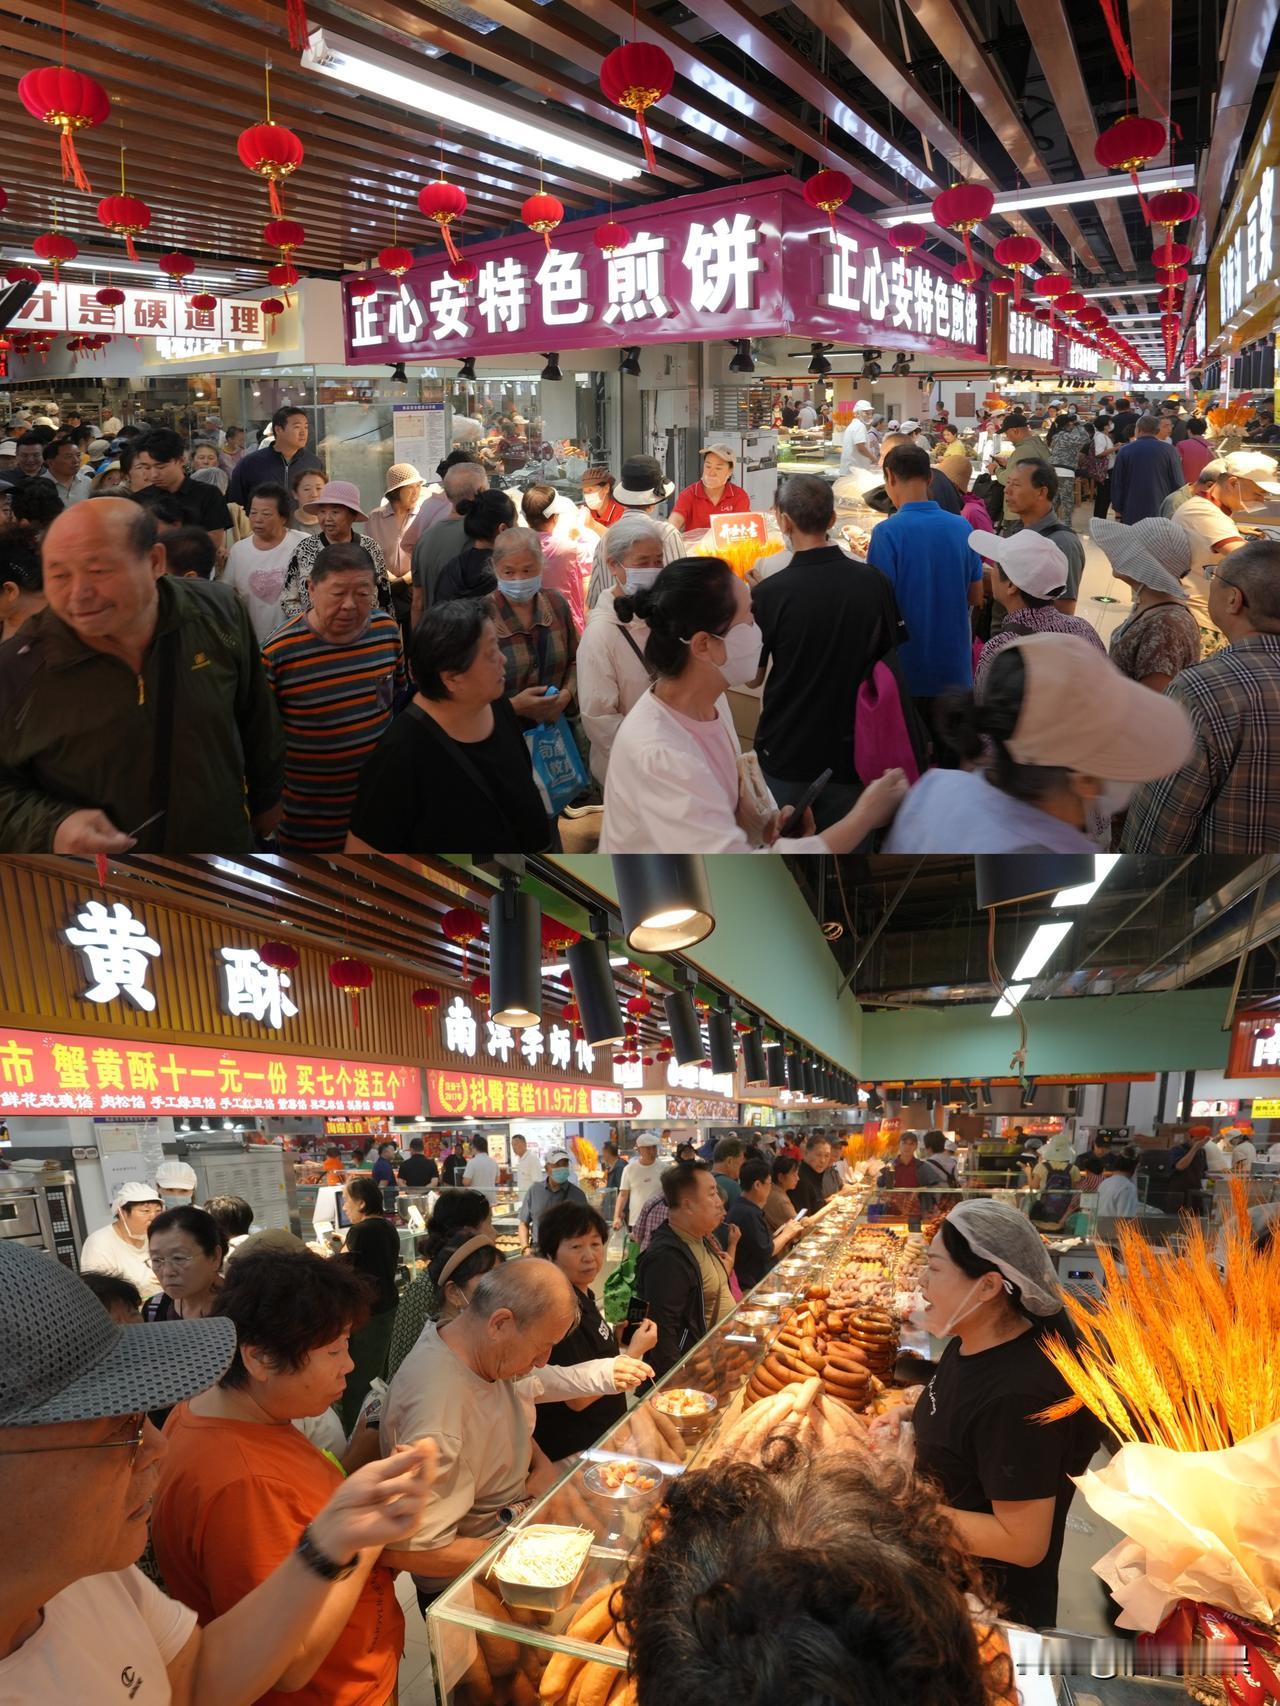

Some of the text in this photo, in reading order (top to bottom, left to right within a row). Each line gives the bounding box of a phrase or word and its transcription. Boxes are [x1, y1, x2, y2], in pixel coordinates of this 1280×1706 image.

[351, 213, 761, 347] 正心安特色煎饼
[826, 232, 977, 346] 正心安特色煎饼
[0, 1039, 400, 1100] 市 蟹黄酥十一元一份 买七个送五个
[469, 1076, 589, 1114] 抖臀蛋糕11.9元/盒
